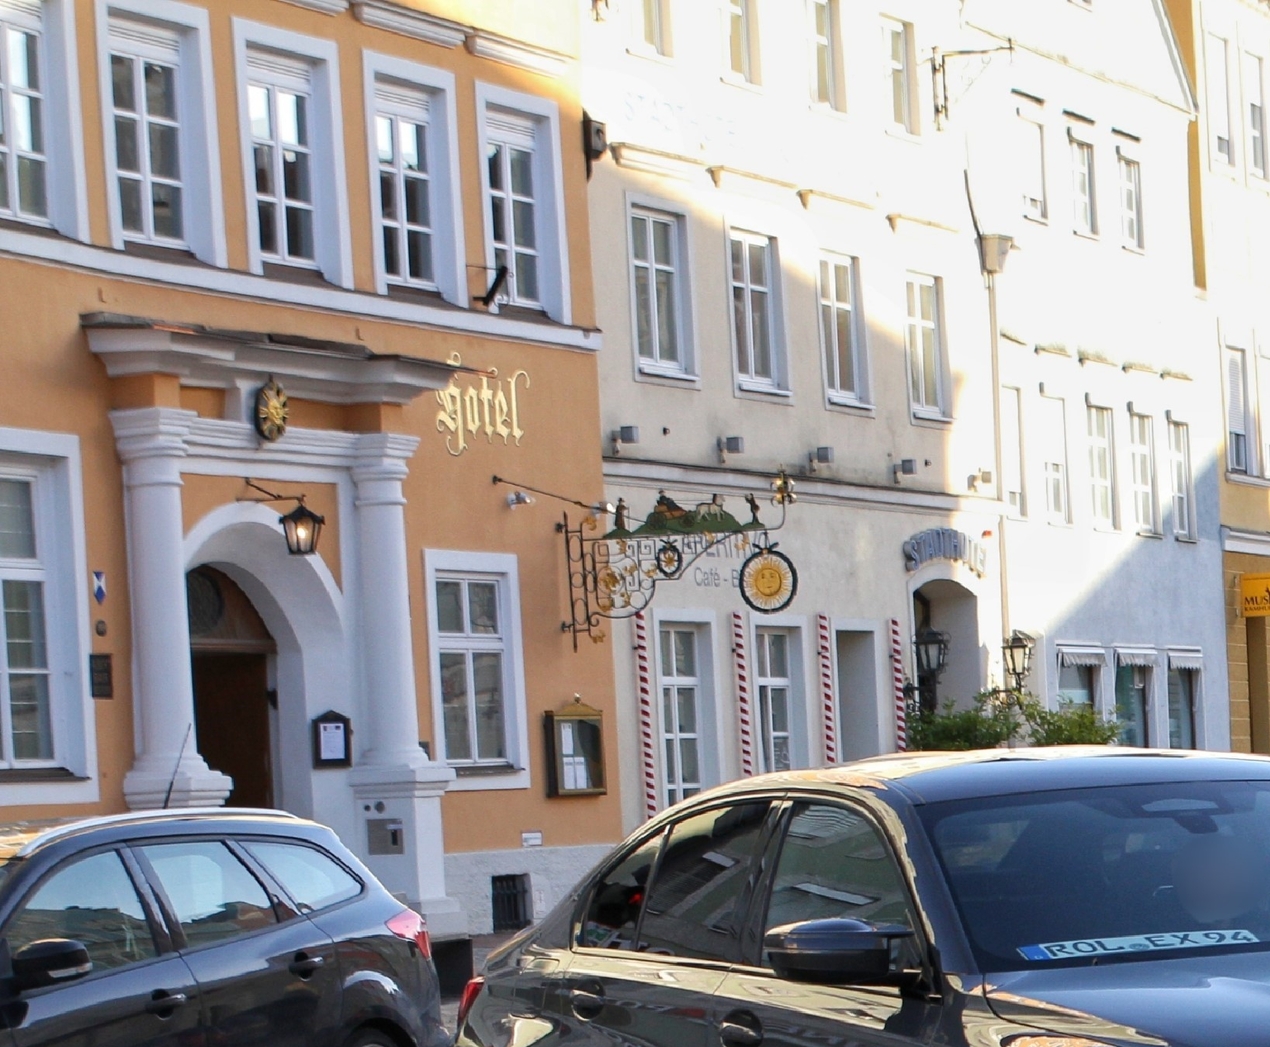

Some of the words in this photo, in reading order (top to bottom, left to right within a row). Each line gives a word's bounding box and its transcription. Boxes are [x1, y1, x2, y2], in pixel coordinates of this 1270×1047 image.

[694, 567, 720, 587] Café
[1044, 940, 1126, 957] ROL
[1150, 933, 1199, 948] EX
[1202, 930, 1254, 944] 94
